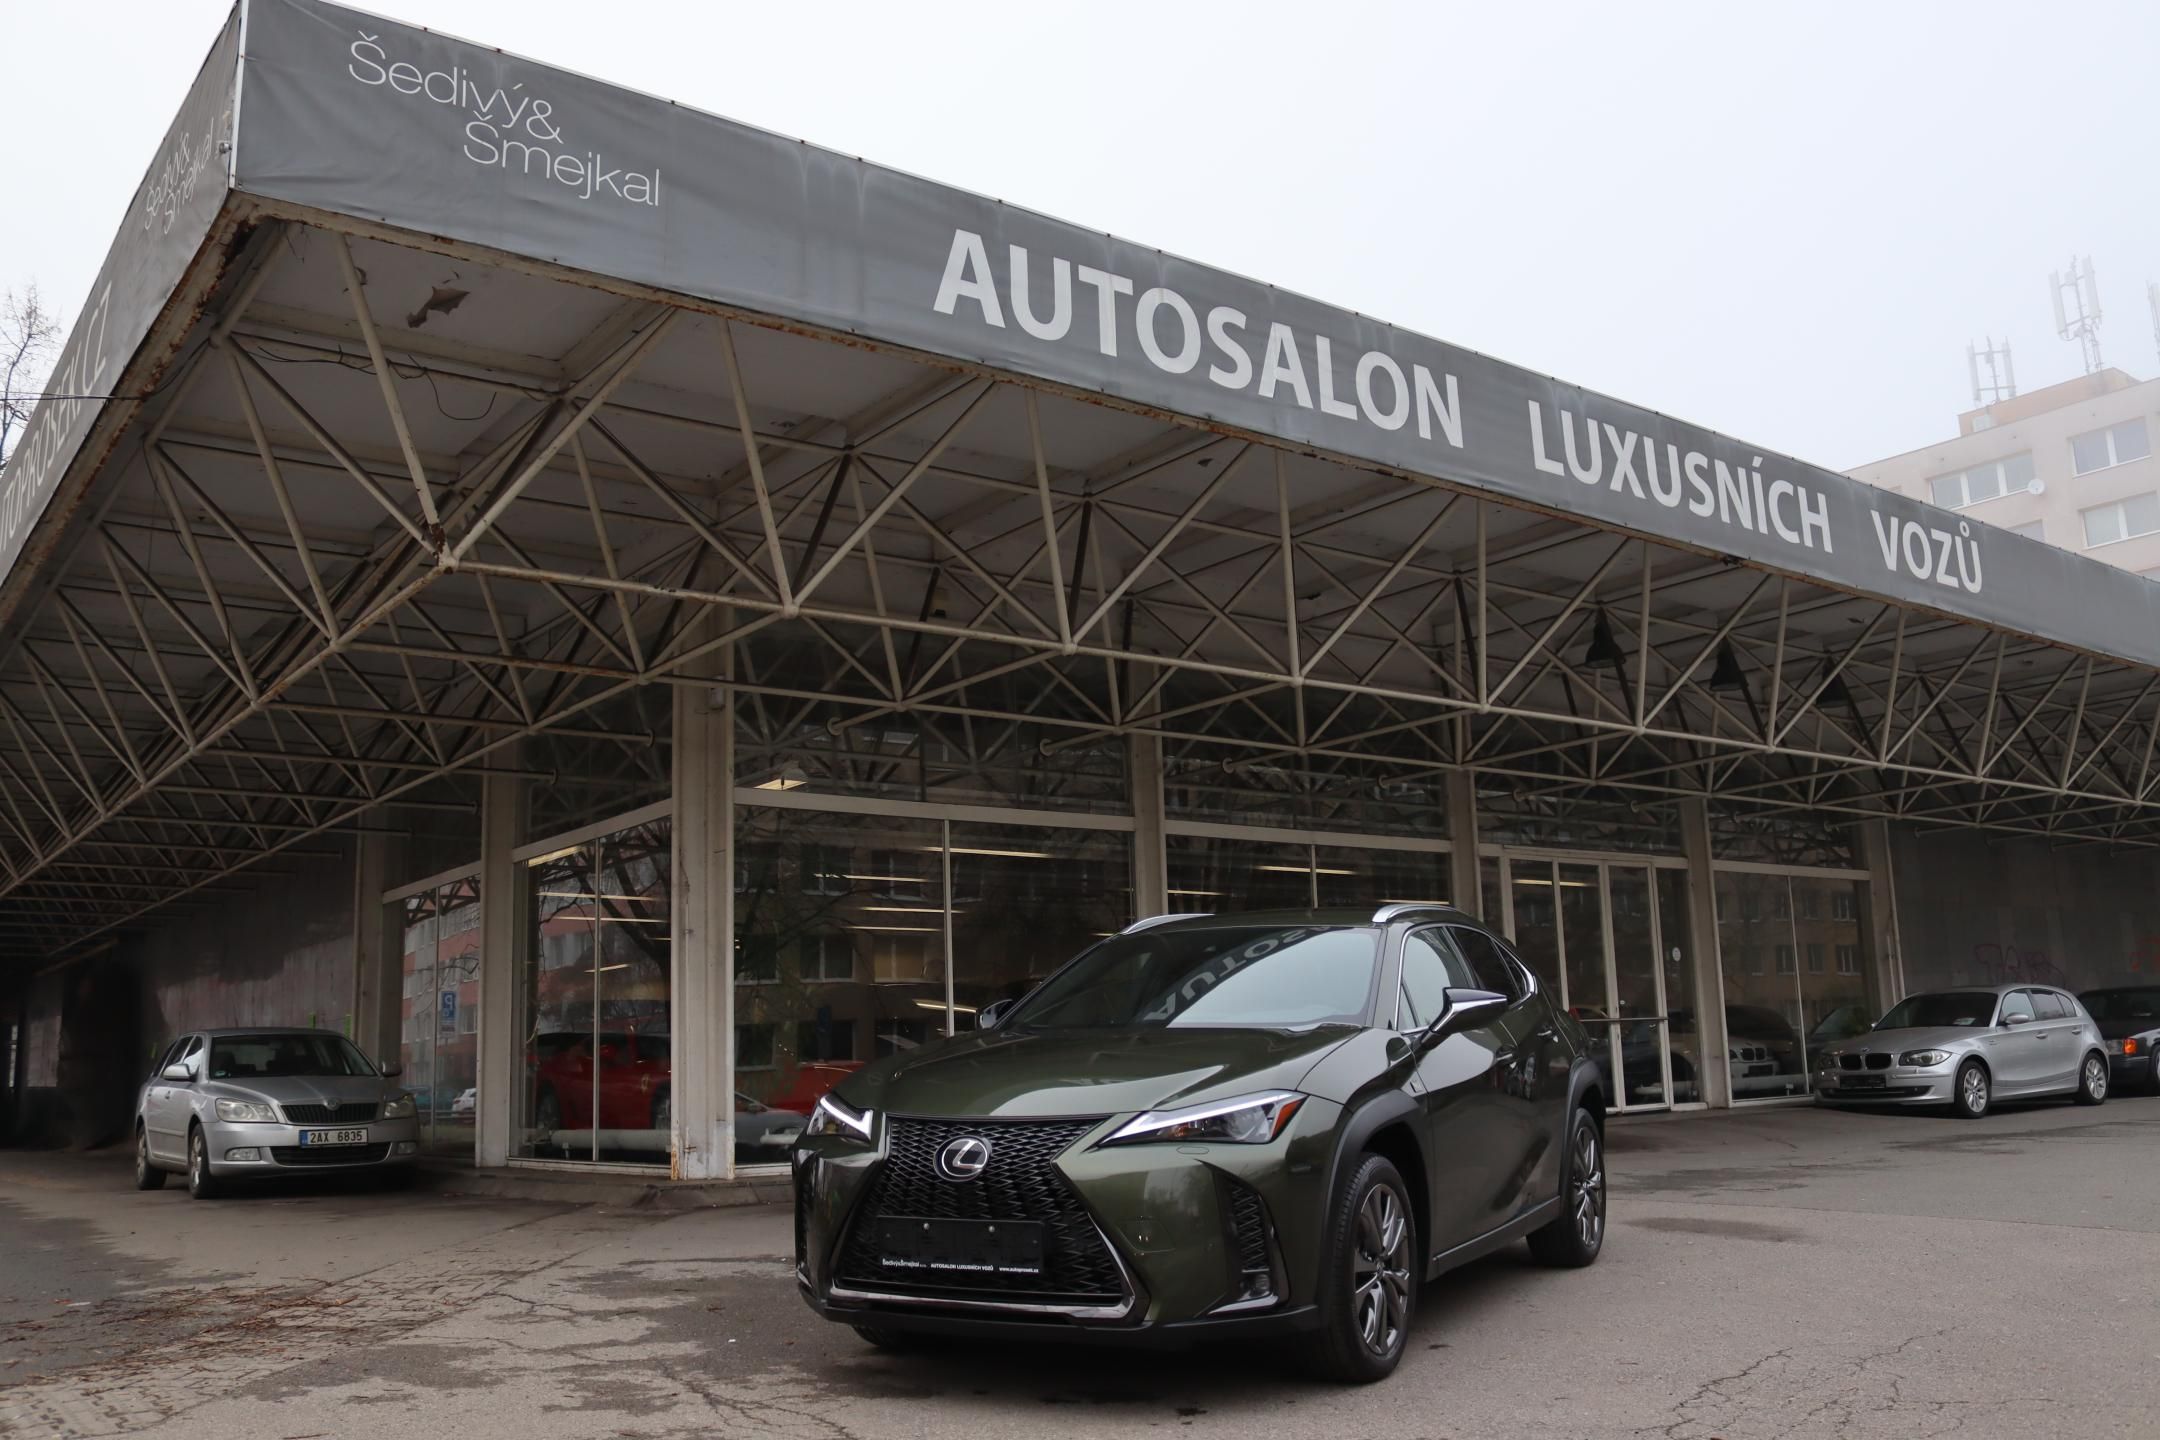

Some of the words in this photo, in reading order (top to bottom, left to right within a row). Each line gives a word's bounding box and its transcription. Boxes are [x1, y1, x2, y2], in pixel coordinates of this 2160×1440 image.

[349, 30, 564, 144] Šedivý&
[464, 110, 660, 206] Šmejkal
[0, 280, 111, 551] TOPROSEK.CZ
[933, 229, 1464, 449] AUTOSALON
[1528, 400, 1833, 554] LUXUSNÍCH
[1871, 509, 1983, 594] VOZŮ
[310, 1132, 329, 1143] 2AX
